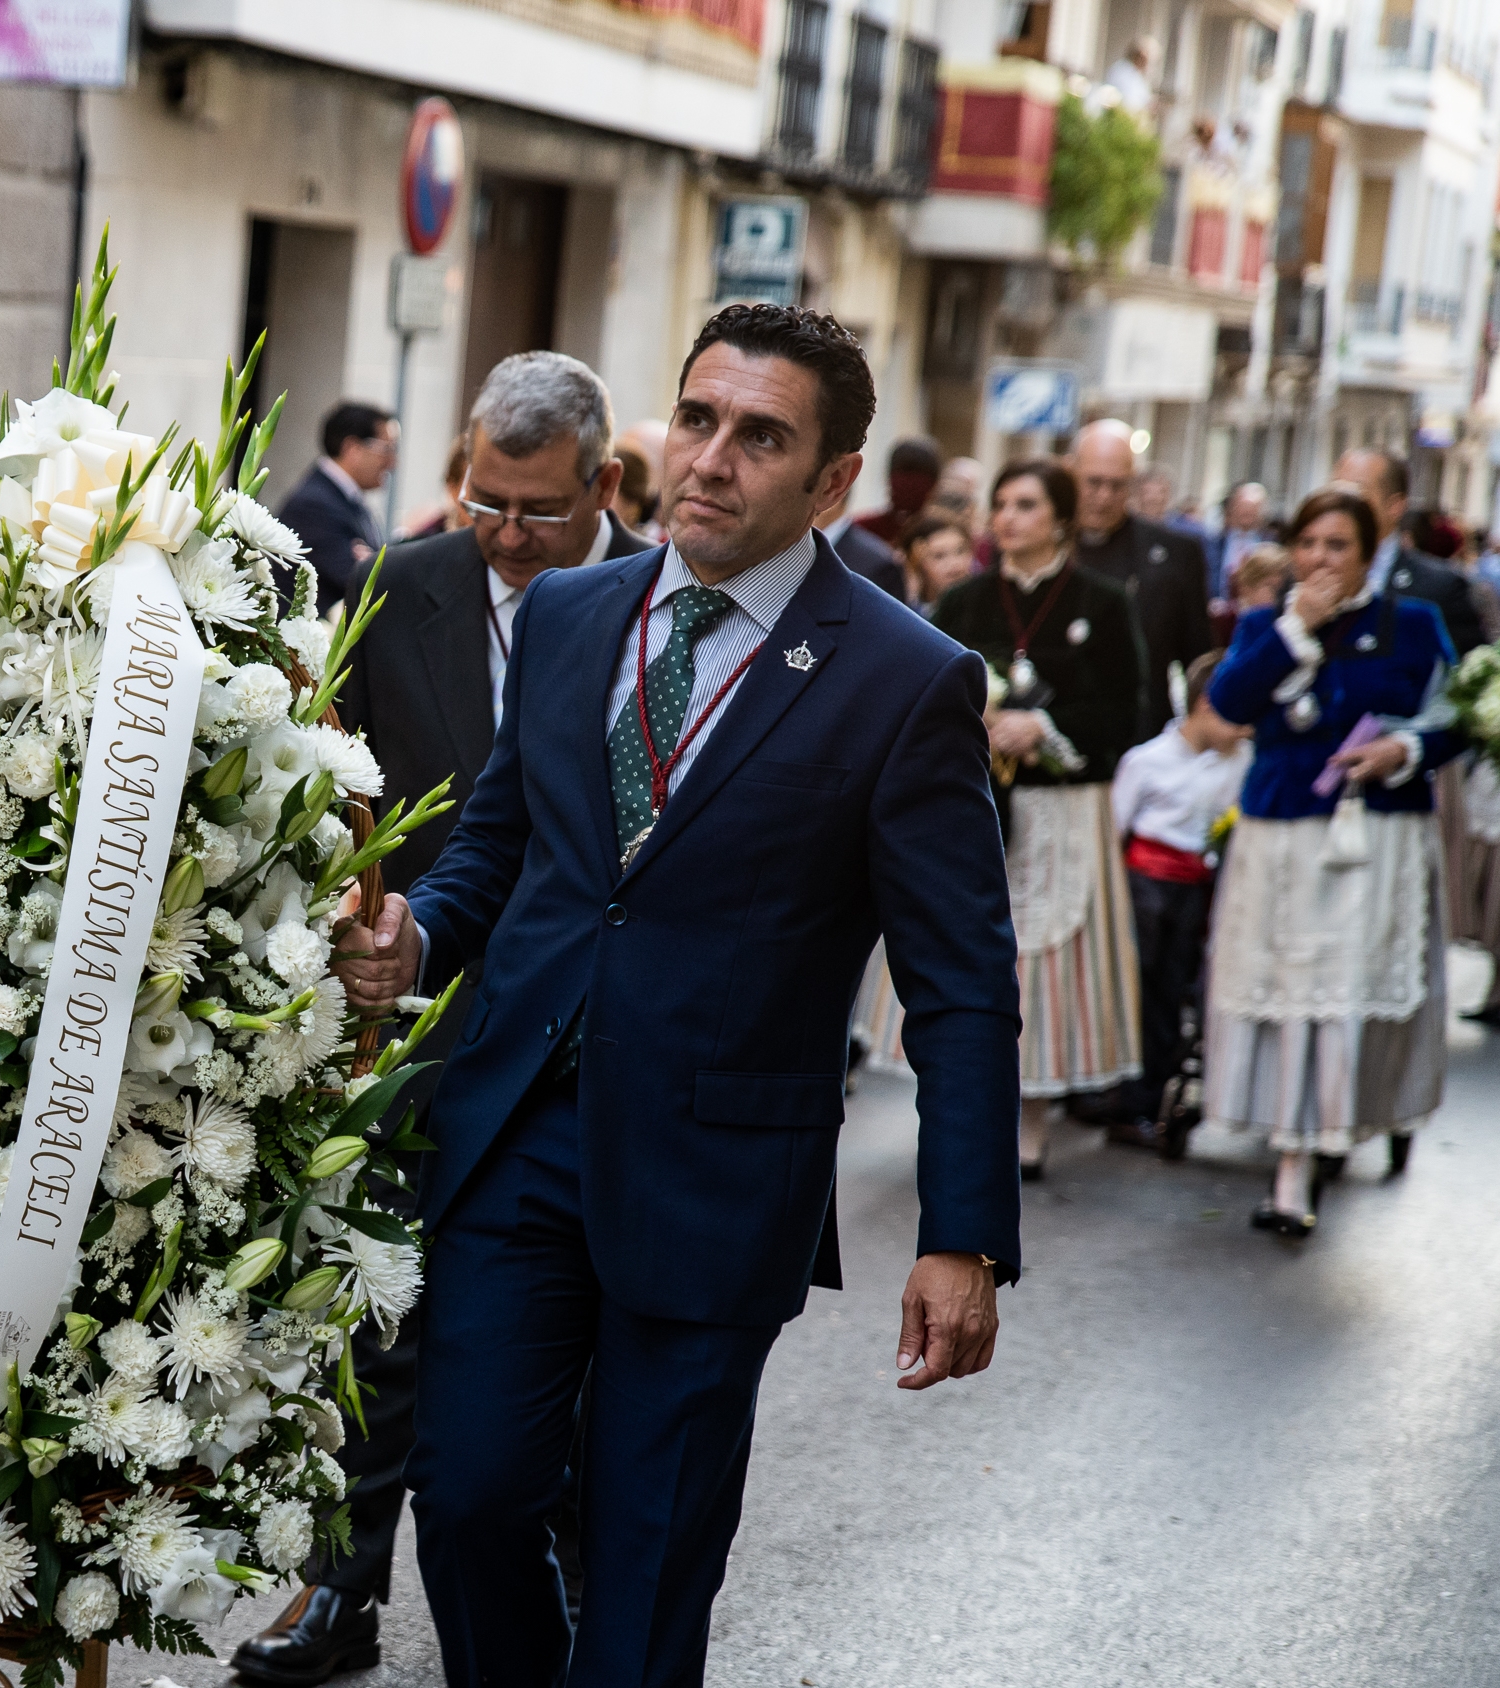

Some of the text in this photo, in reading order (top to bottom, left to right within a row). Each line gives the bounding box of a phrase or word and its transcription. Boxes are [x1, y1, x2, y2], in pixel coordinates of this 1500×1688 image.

[17, 594, 182, 1250] MARIA SANTÍSIMA DE ARACELI
